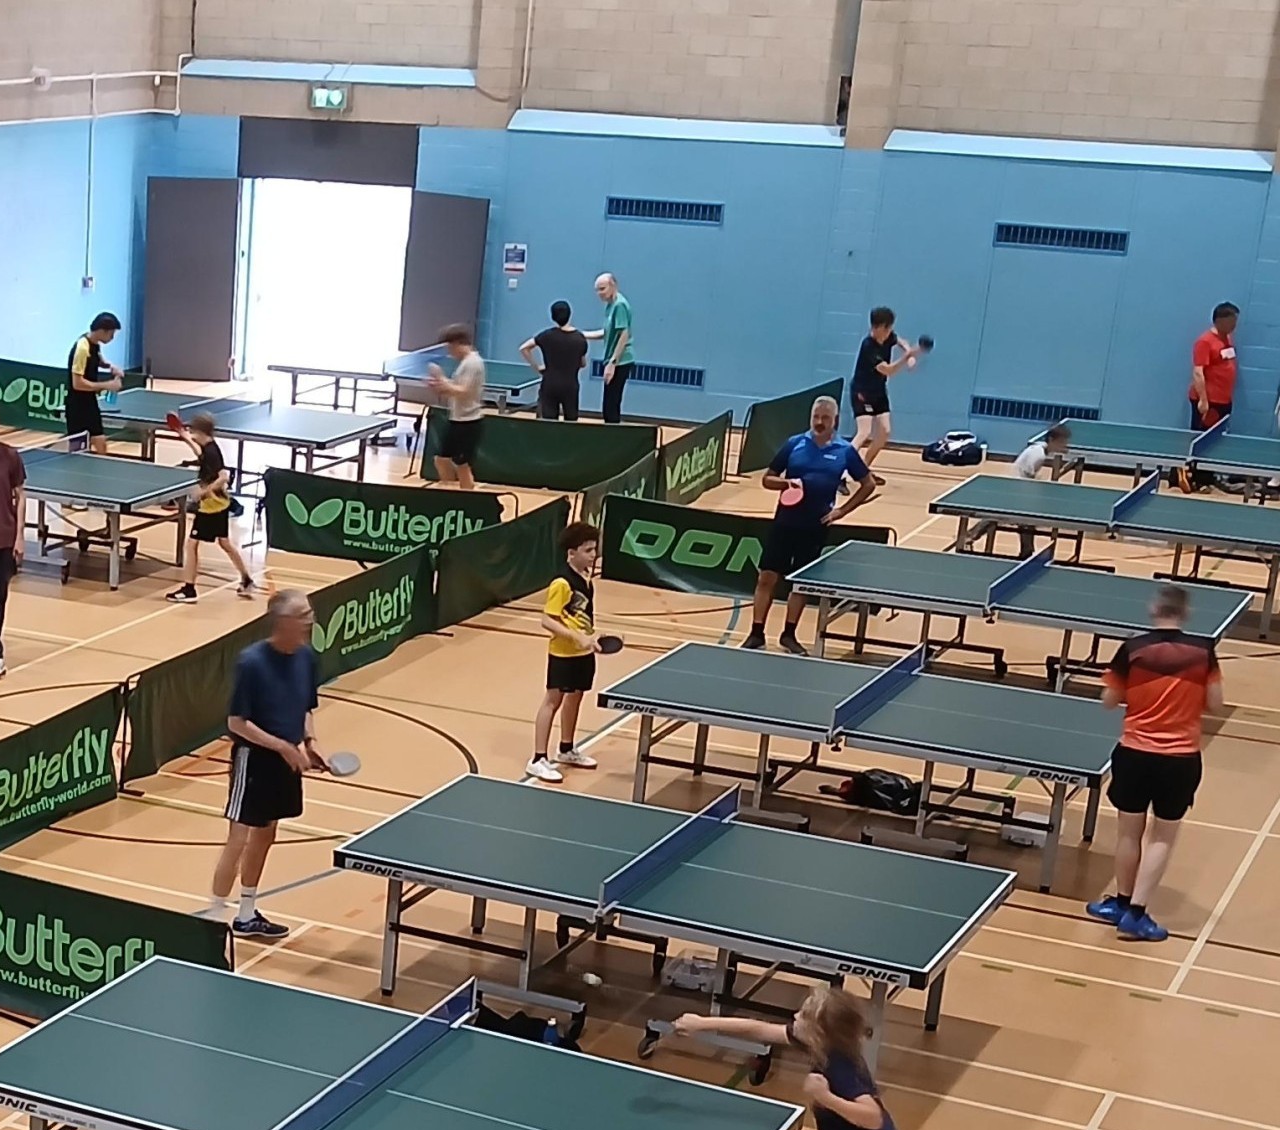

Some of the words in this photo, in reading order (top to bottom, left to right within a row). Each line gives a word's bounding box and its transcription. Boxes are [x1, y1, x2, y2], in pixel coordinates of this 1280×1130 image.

[620, 519, 763, 572] DON
[613, 702, 658, 714] DONIC
[1028, 769, 1081, 784] DONIC
[351, 861, 403, 878] DONIC
[838, 963, 901, 983] DONIC
